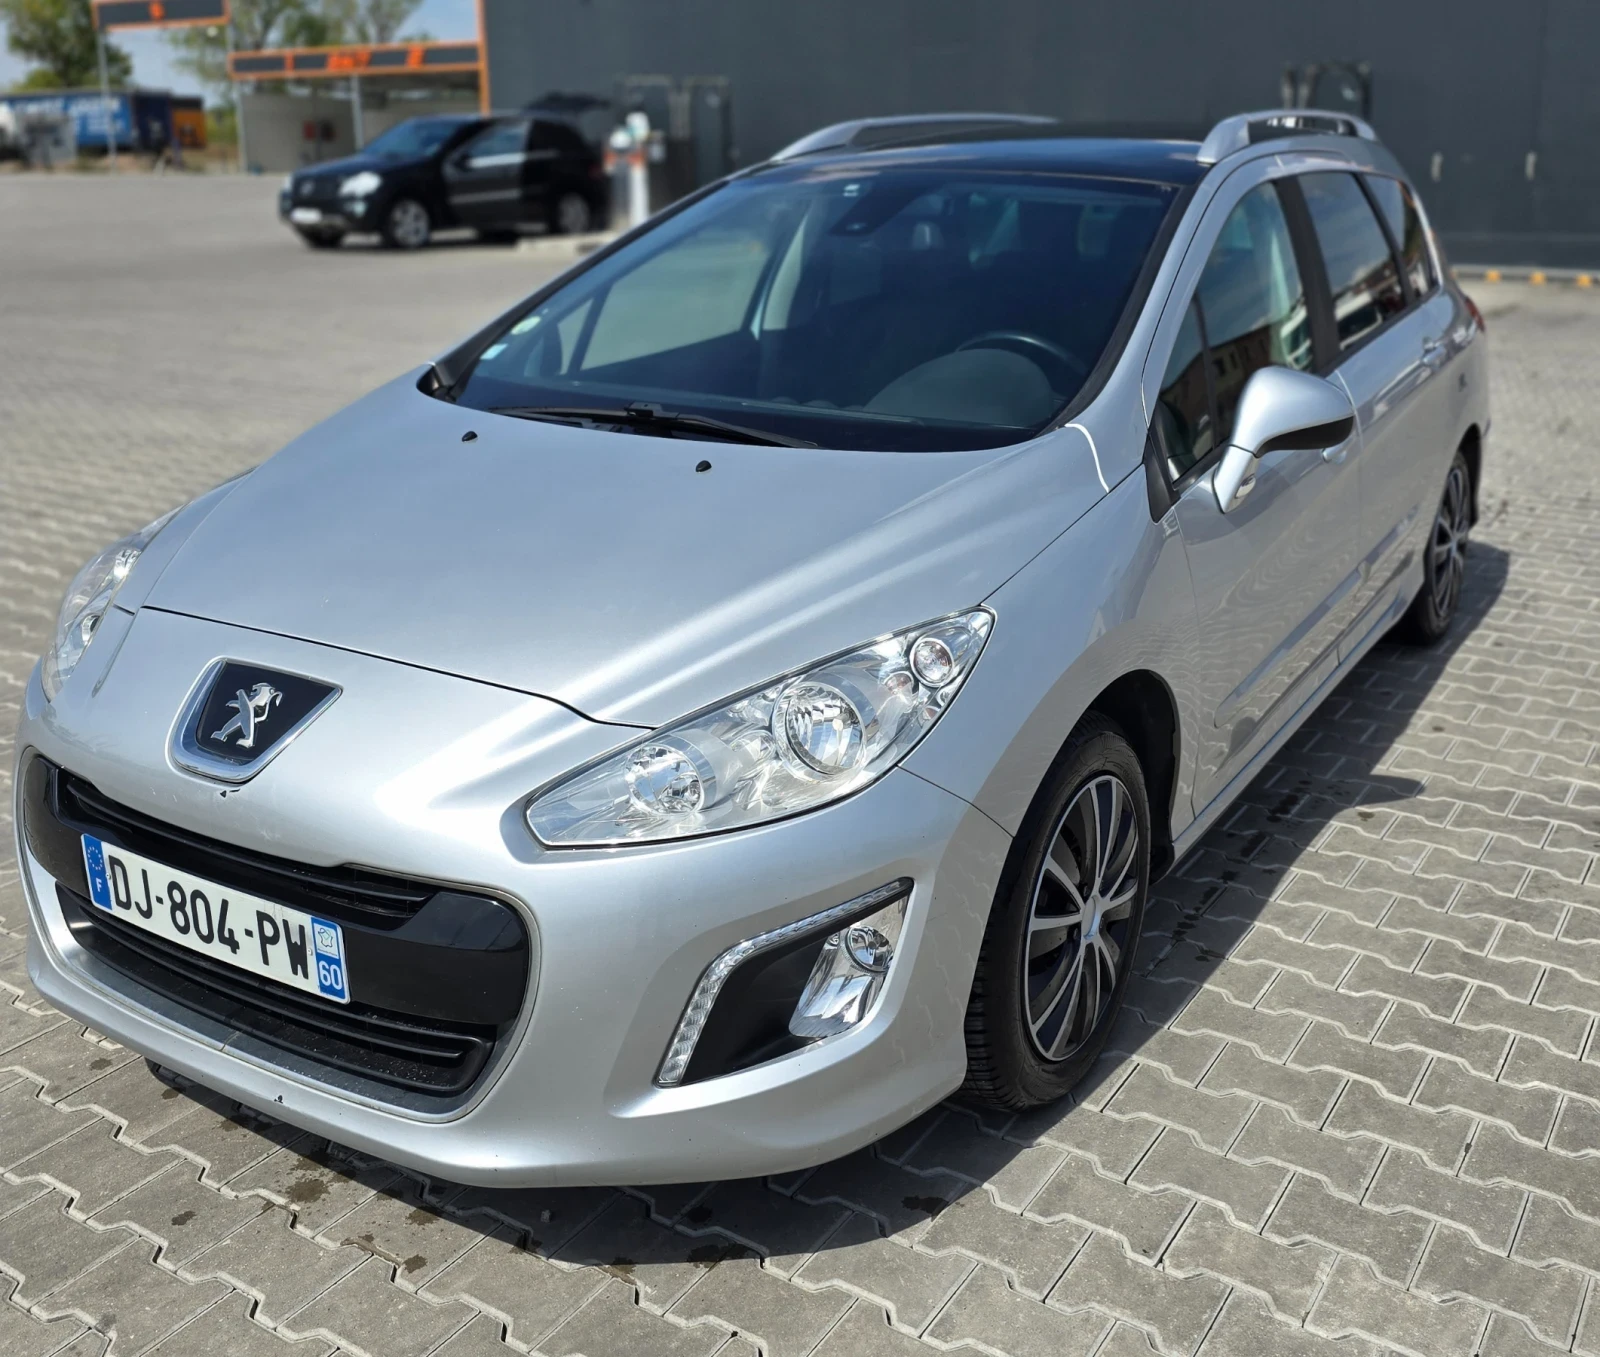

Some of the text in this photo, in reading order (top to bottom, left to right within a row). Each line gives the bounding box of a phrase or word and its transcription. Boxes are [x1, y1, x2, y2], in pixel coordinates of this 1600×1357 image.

[96, 878, 103, 893] F
[109, 855, 309, 980] DJ-804-PW
[319, 961, 342, 990] 60
